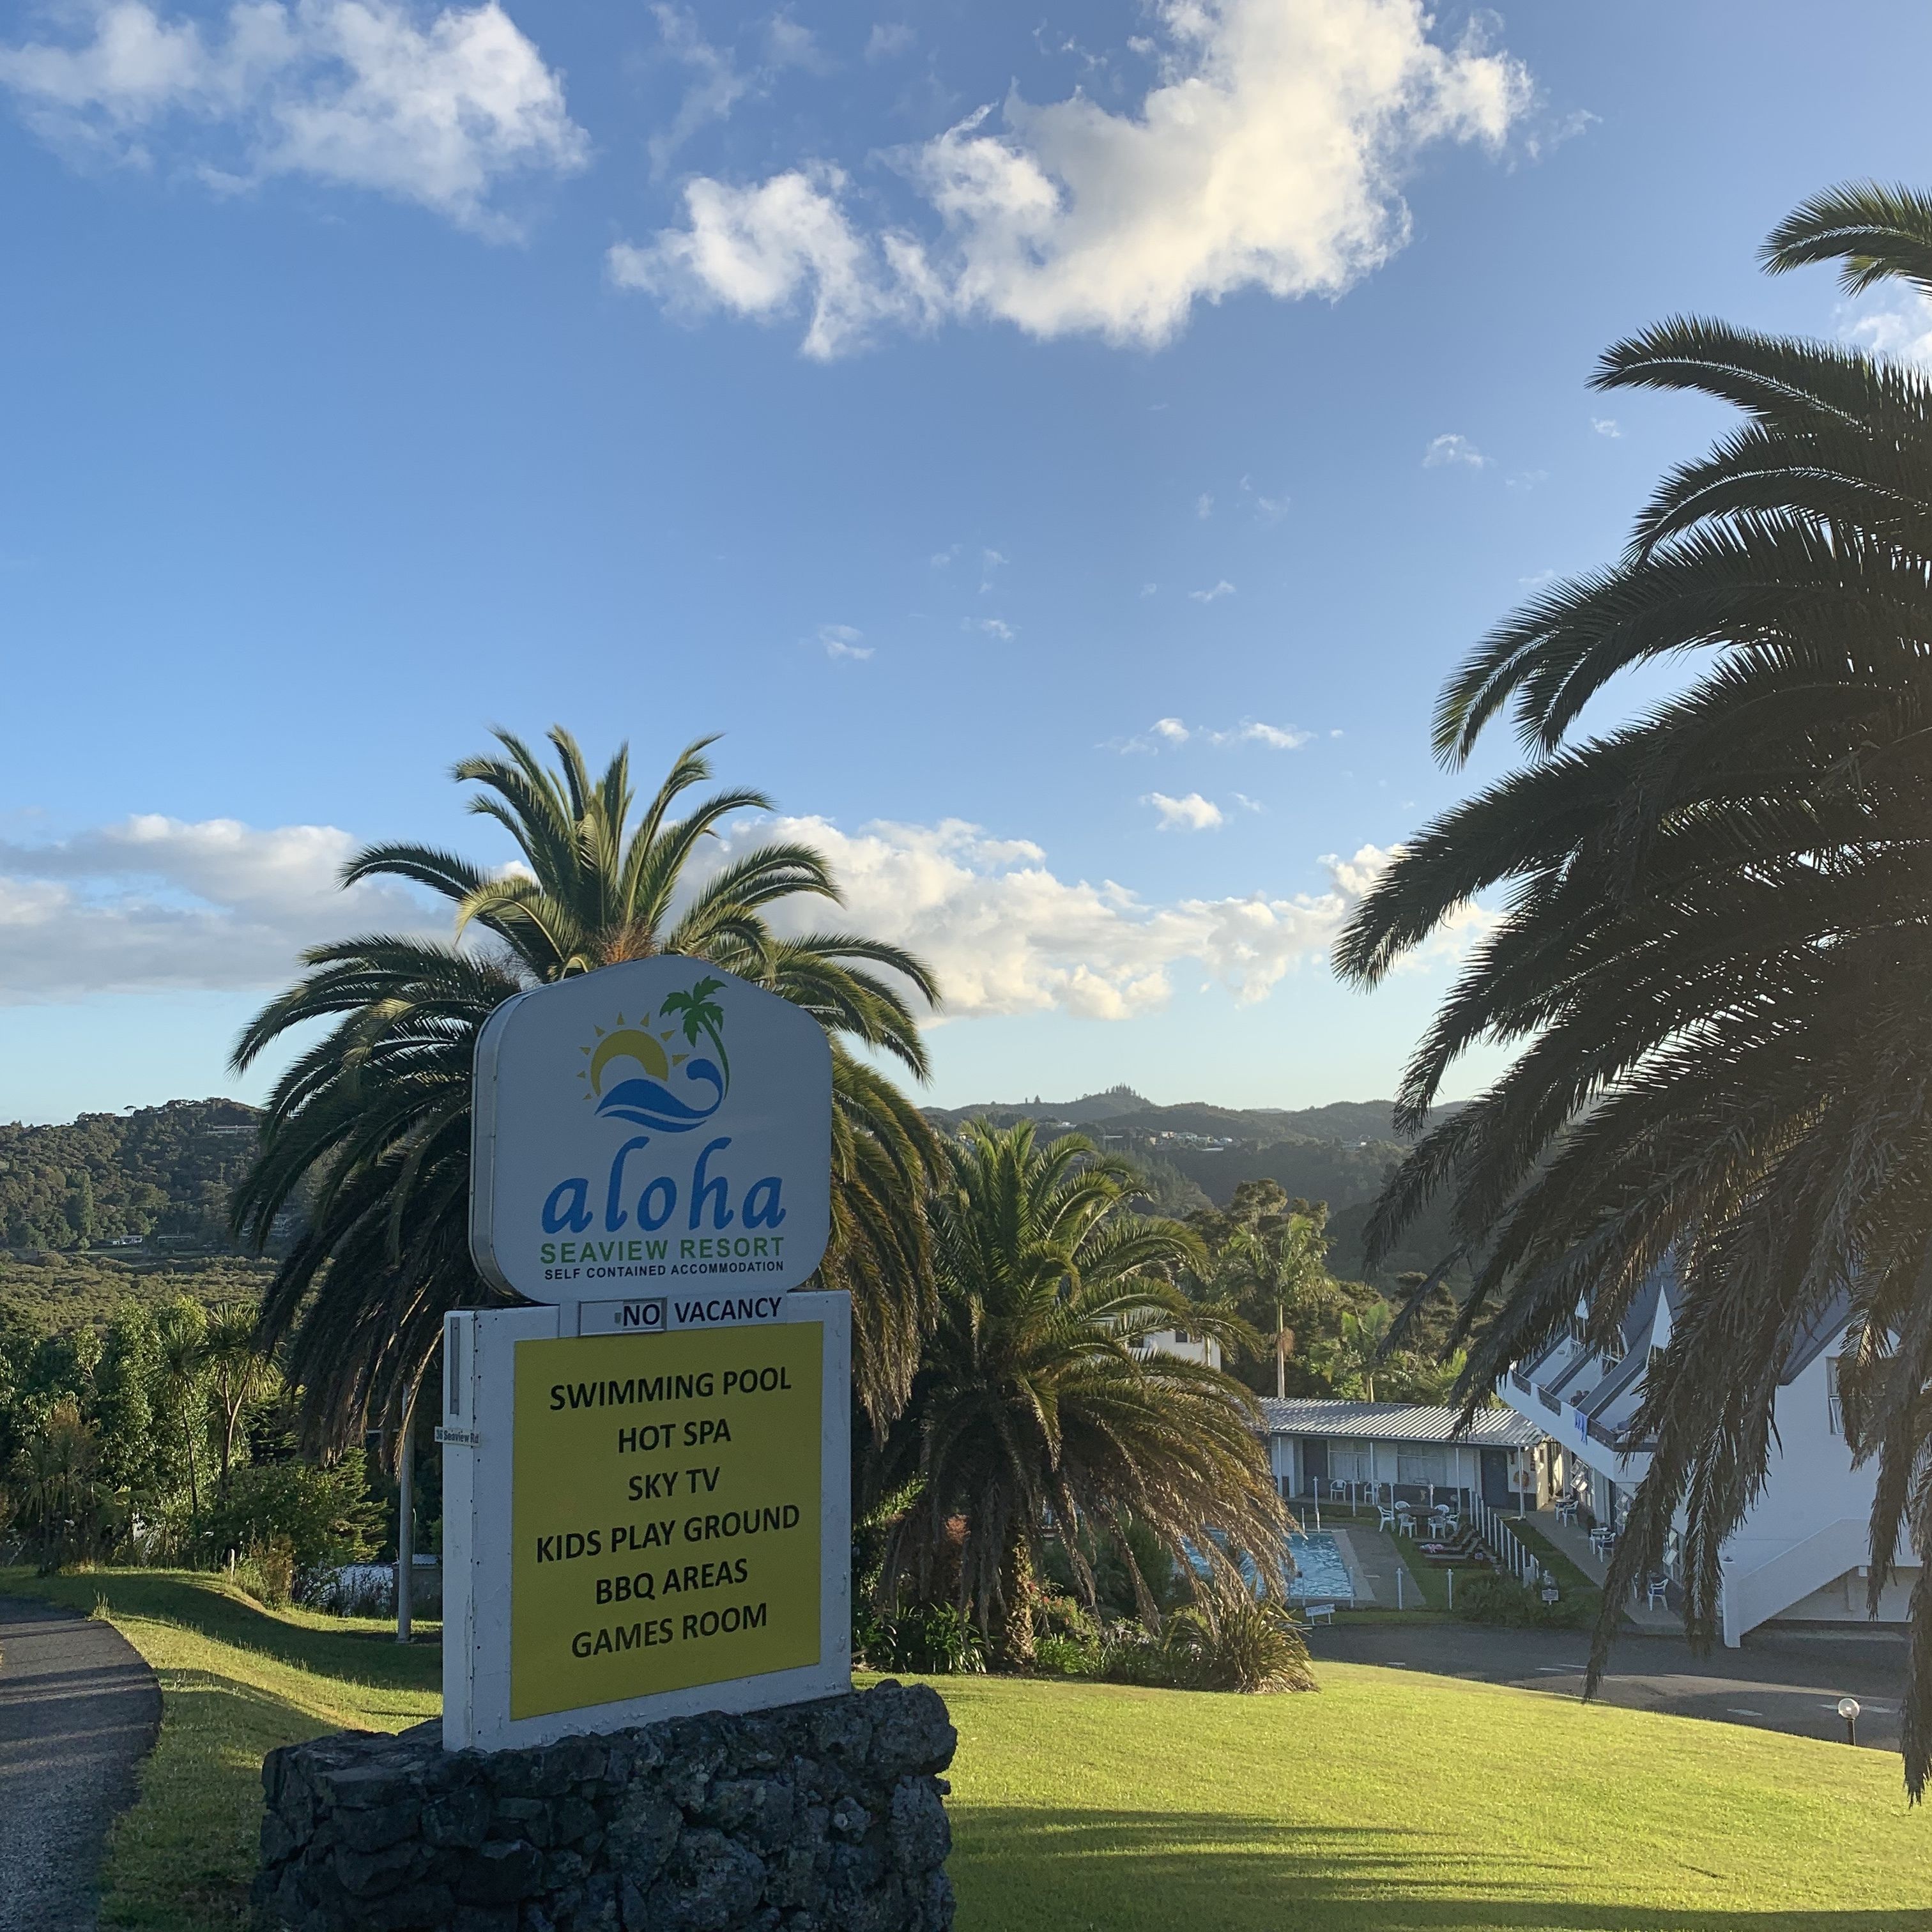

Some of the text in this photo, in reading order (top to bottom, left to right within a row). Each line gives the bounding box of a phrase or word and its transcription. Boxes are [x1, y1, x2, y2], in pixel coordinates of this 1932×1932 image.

[541, 1136, 786, 1234] aloha
[540, 1237, 785, 1264] SEAVIEW RESORT
[544, 1261, 784, 1280] SELF CONTAINED ACCOMMODATION
[622, 1297, 783, 1327] NO VACANCY
[549, 1367, 792, 1411] SWIMMING POOL
[444, 1430, 470, 1442] Seaview
[470, 1433, 479, 1443] Rd
[618, 1418, 732, 1453] HOT SPA
[628, 1467, 721, 1501] SKY TV
[536, 1505, 800, 1563] KIDS PLAY GROUND
[595, 1558, 749, 1605] BBQ AREAS
[572, 1602, 768, 1658] GAMES ROOM
